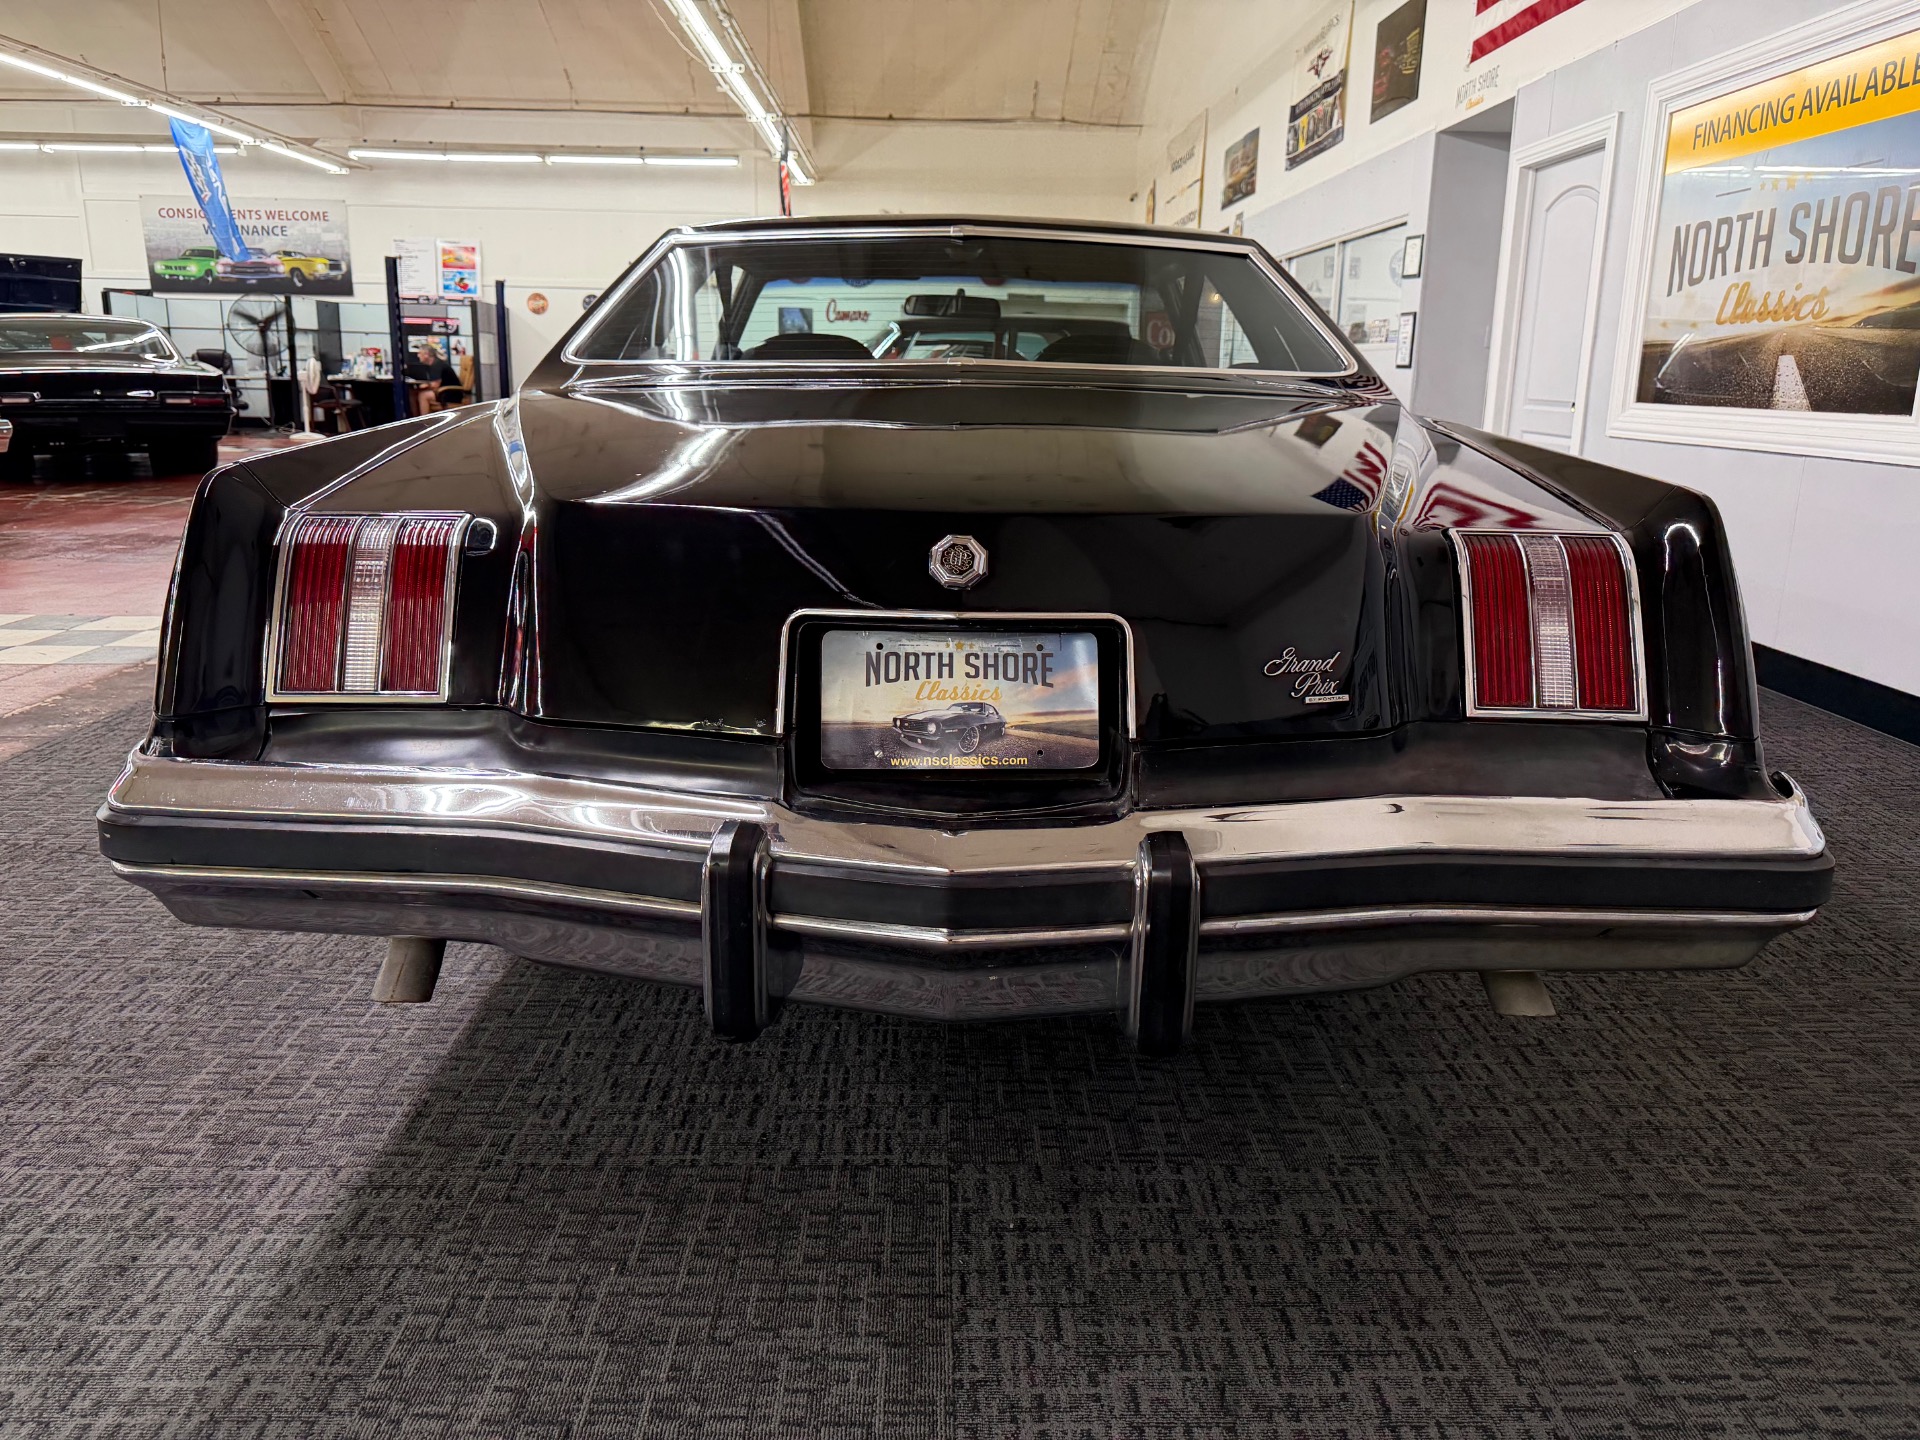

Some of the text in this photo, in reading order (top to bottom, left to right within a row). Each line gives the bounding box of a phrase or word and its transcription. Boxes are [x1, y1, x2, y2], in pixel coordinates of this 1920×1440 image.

[1692, 52, 1920, 150] FINANCING AVAILABLE
[158, 207, 330, 222] CONSIGENTS WELCOME
[1667, 181, 1920, 297] NORTH SHORE
[1716, 281, 1830, 325] Classics
[865, 651, 1054, 688] NORTH SHORE
[1263, 646, 1341, 676] Grand
[915, 680, 1002, 701] Classics
[1290, 671, 1340, 698] Prix
[890, 753, 1028, 767] www.nsclassics.com
